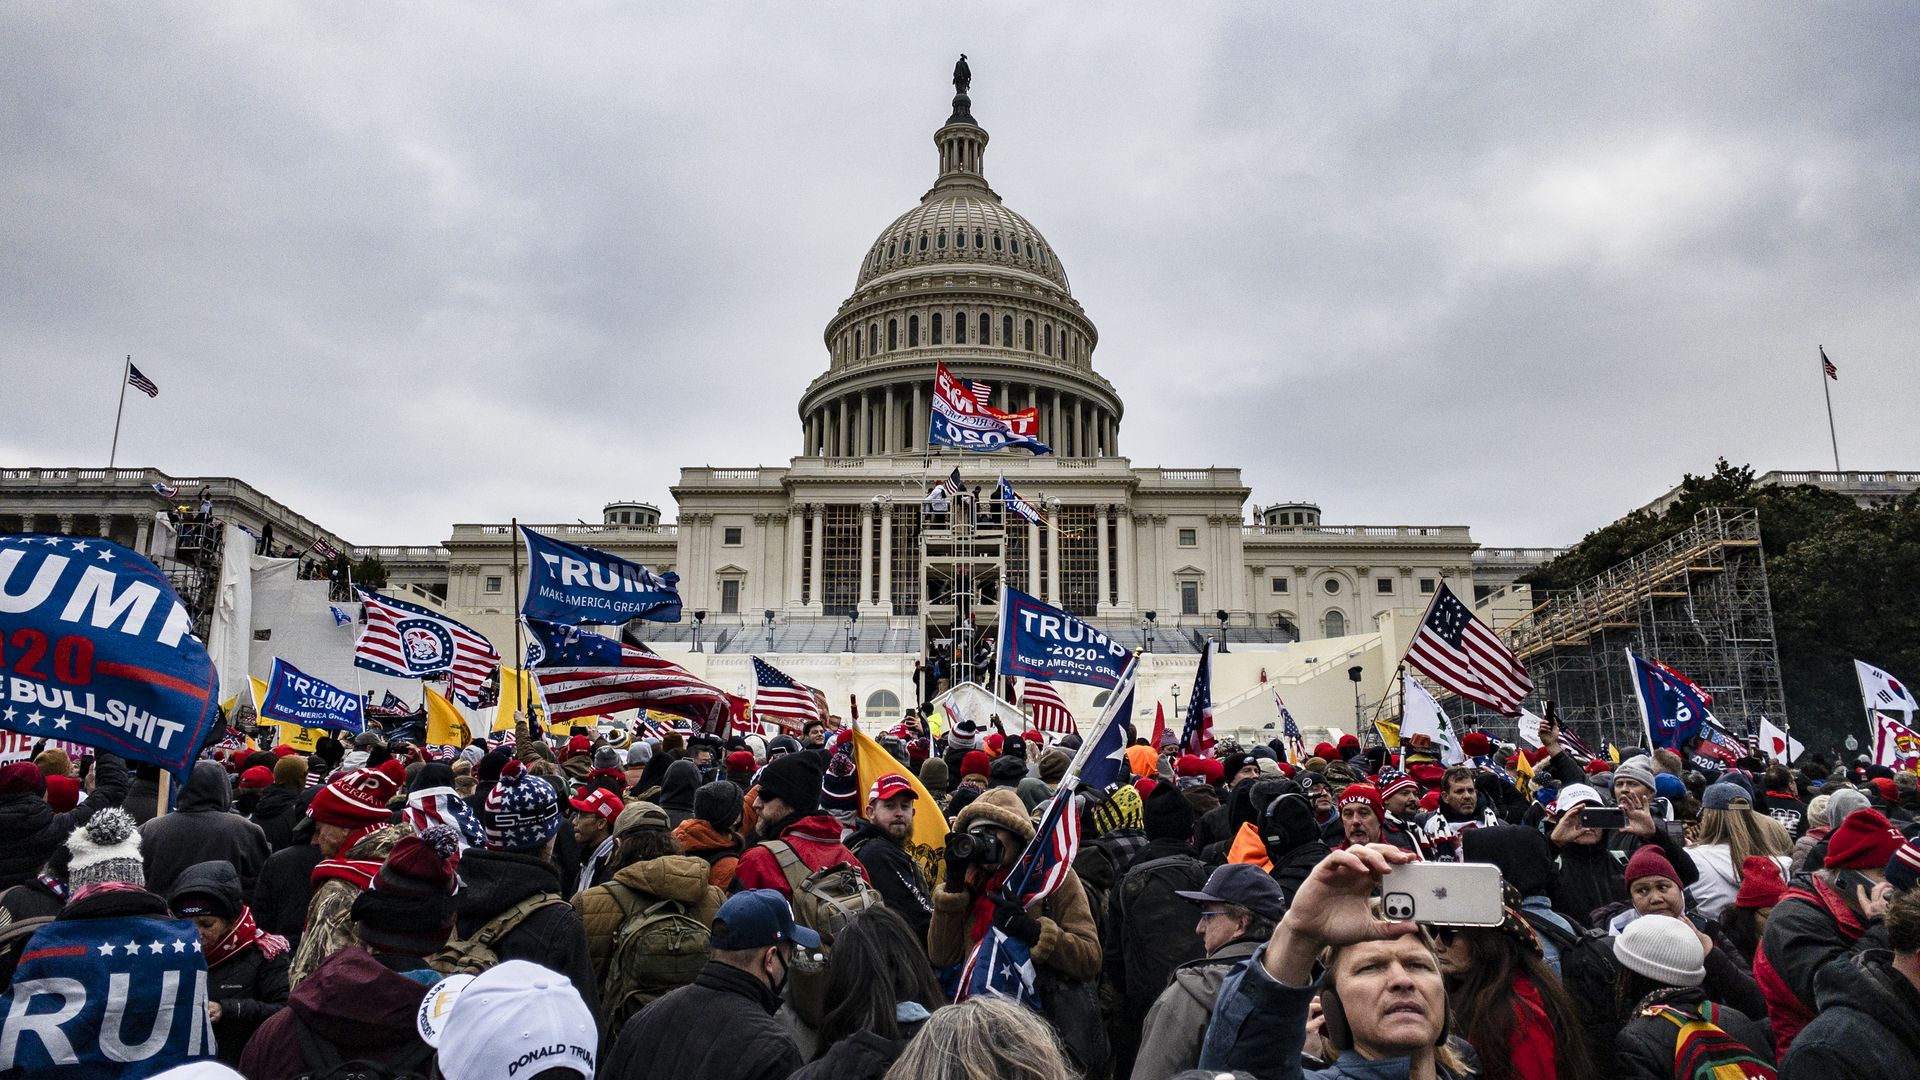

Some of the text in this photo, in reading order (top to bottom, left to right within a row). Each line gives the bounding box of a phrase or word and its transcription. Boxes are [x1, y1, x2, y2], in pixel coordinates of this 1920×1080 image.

[540, 585, 564, 604] MAKE
[565, 594, 611, 611] AMERICA
[613, 600, 645, 613] GREAT
[1020, 608, 1126, 657] TRUMP
[1018, 654, 1044, 668] KEEP
[1046, 658, 1093, 672] AMERICA
[283, 671, 358, 714] TRUMP
[10, 676, 186, 750] BULLSHIT
[275, 703, 294, 714] KEEP
[295, 710, 327, 719] AMERICA
[1340, 795, 1371, 808] TRUMP
[508, 1044, 566, 1077] DONALD
